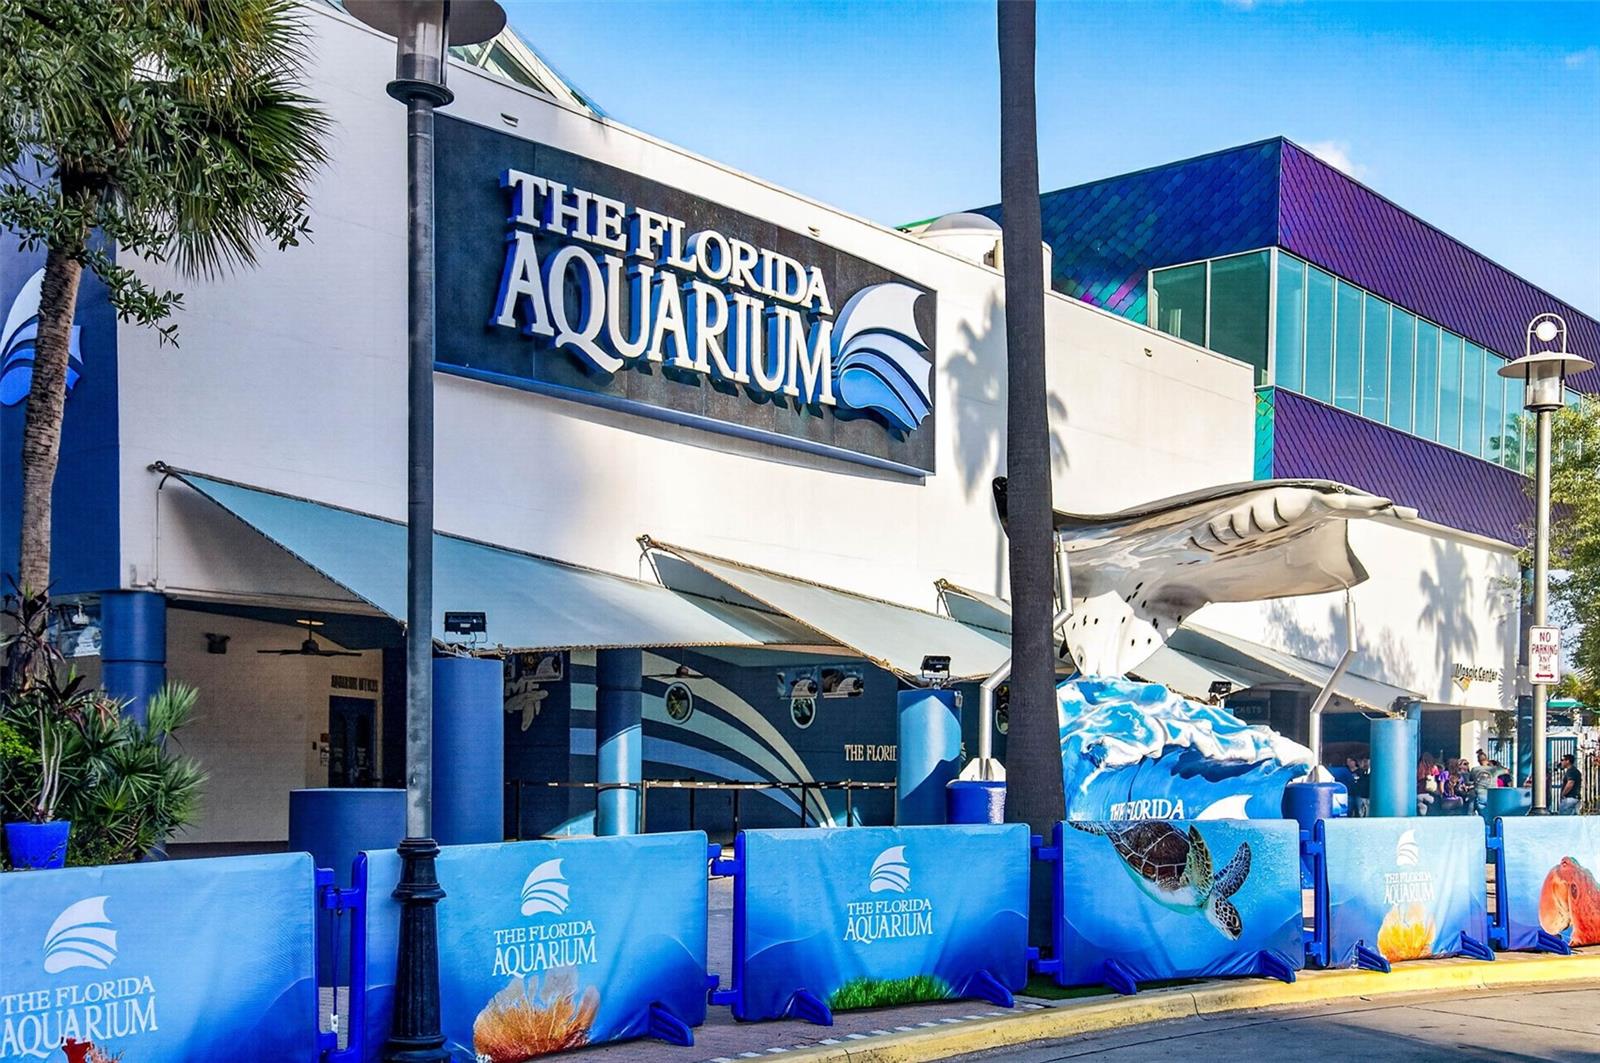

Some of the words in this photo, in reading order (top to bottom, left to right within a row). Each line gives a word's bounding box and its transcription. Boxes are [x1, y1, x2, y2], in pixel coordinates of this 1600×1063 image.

[507, 168, 627, 252] THE
[633, 206, 834, 316] FLORIDA
[496, 230, 836, 406] AQUARIUM
[1531, 643, 1558, 656] PARKING
[1539, 631, 1552, 643] NO
[843, 744, 865, 761] THE
[1126, 798, 1185, 821] FLORIDA
[846, 901, 873, 916] THE
[875, 898, 933, 914] FLORIDA
[493, 927, 527, 946] THE
[528, 919, 597, 942] FLORIDA
[843, 911, 933, 945] AQUARIUM
[491, 935, 598, 979] AQUARIUM
[1, 989, 51, 1016] THE
[55, 975, 156, 1008] FLORIDA
[0, 995, 159, 1059] AQUARIUM
